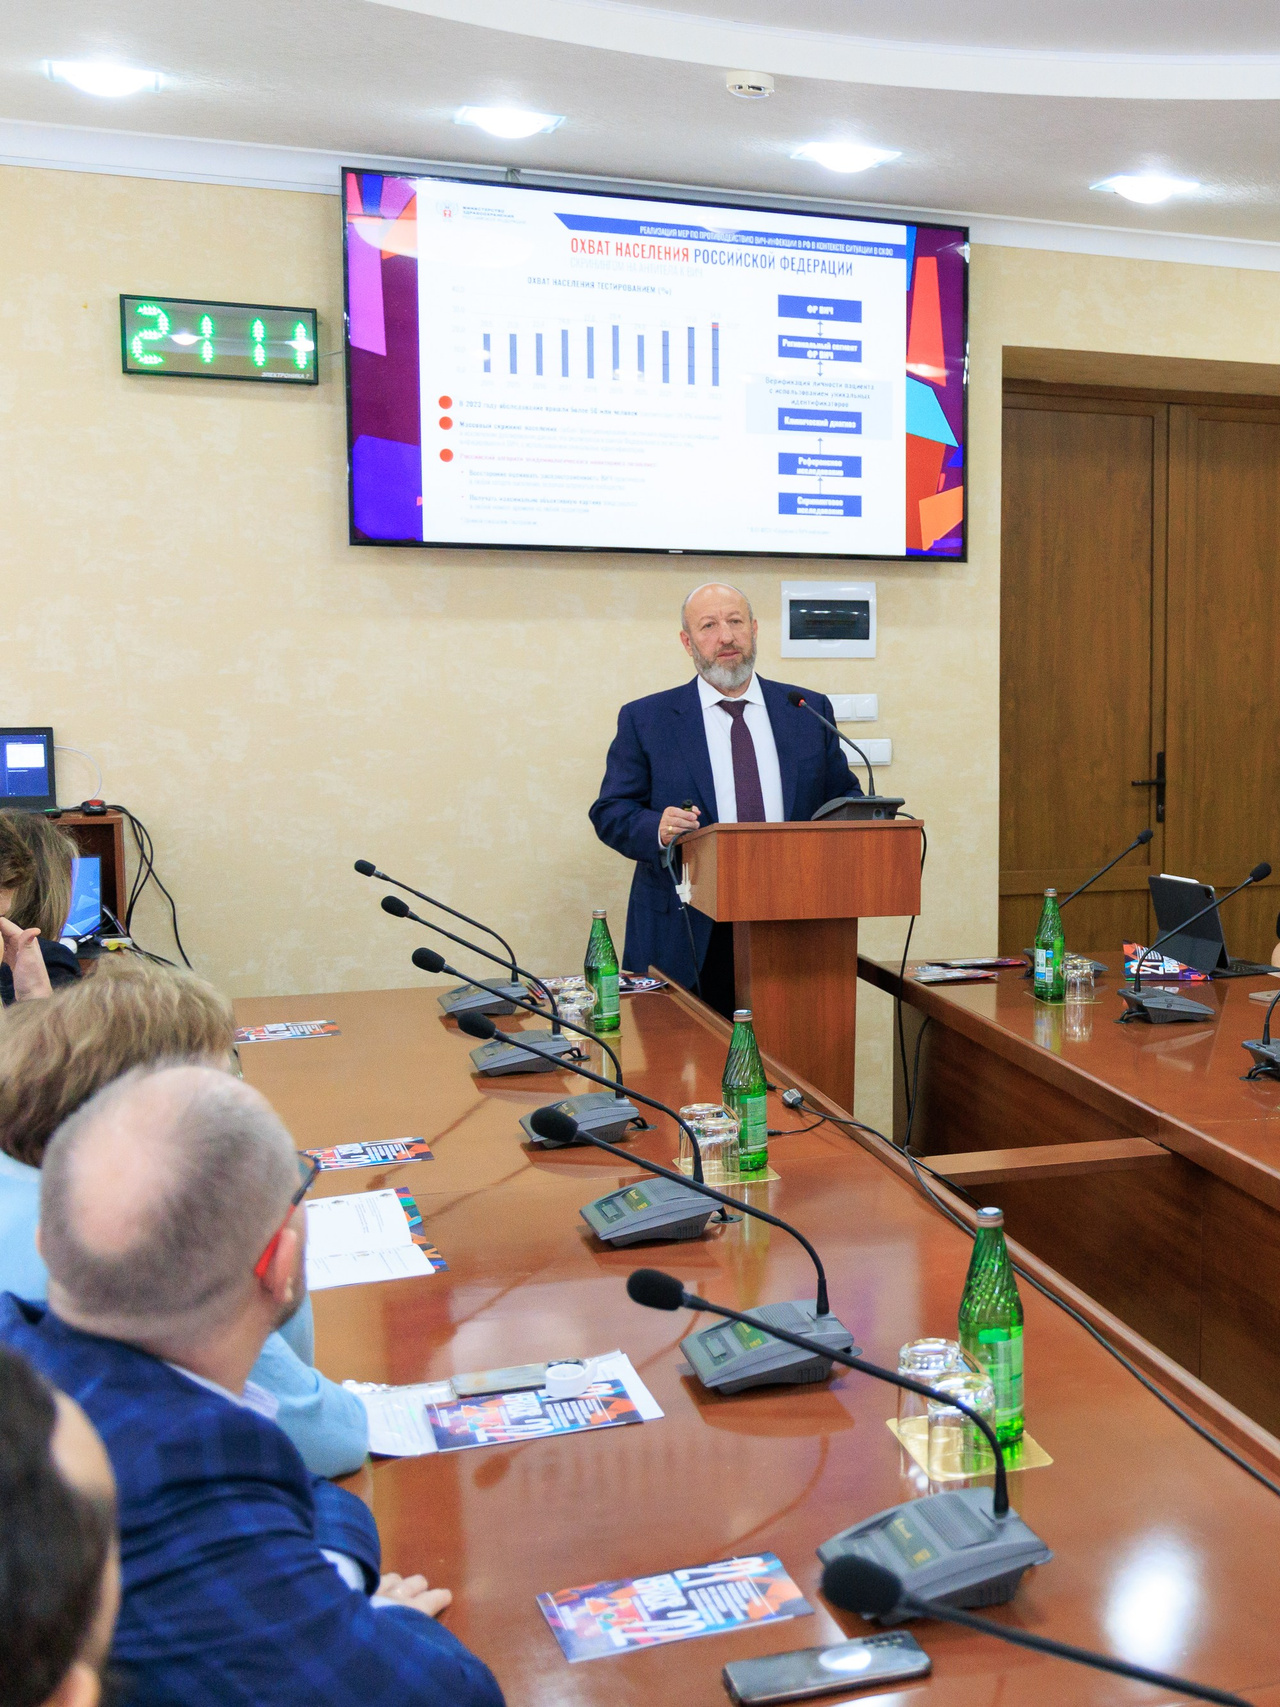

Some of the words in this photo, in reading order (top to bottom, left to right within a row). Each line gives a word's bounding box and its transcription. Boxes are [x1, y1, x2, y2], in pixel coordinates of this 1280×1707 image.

[640, 225, 677, 237] РЕАЛИЗАЦИЯ
[678, 229, 689, 238] МЕР
[690, 230, 698, 239] ПО
[816, 242, 845, 252] КОНТЕКСТЕ
[571, 237, 610, 256] ОХВАТ
[616, 242, 689, 262] НАСЕЛЕНИЯ
[694, 247, 775, 270] РОССИЙСКОЙ
[780, 255, 853, 277] ФЕДЕРАЦИИ
[528, 276, 550, 285] ОХВАТ
[552, 279, 594, 288] НАСЕЛЕНИЯ
[598, 282, 656, 293] ТЕСТИРОВАНИЕМ
[766, 376, 810, 388] Верификация
